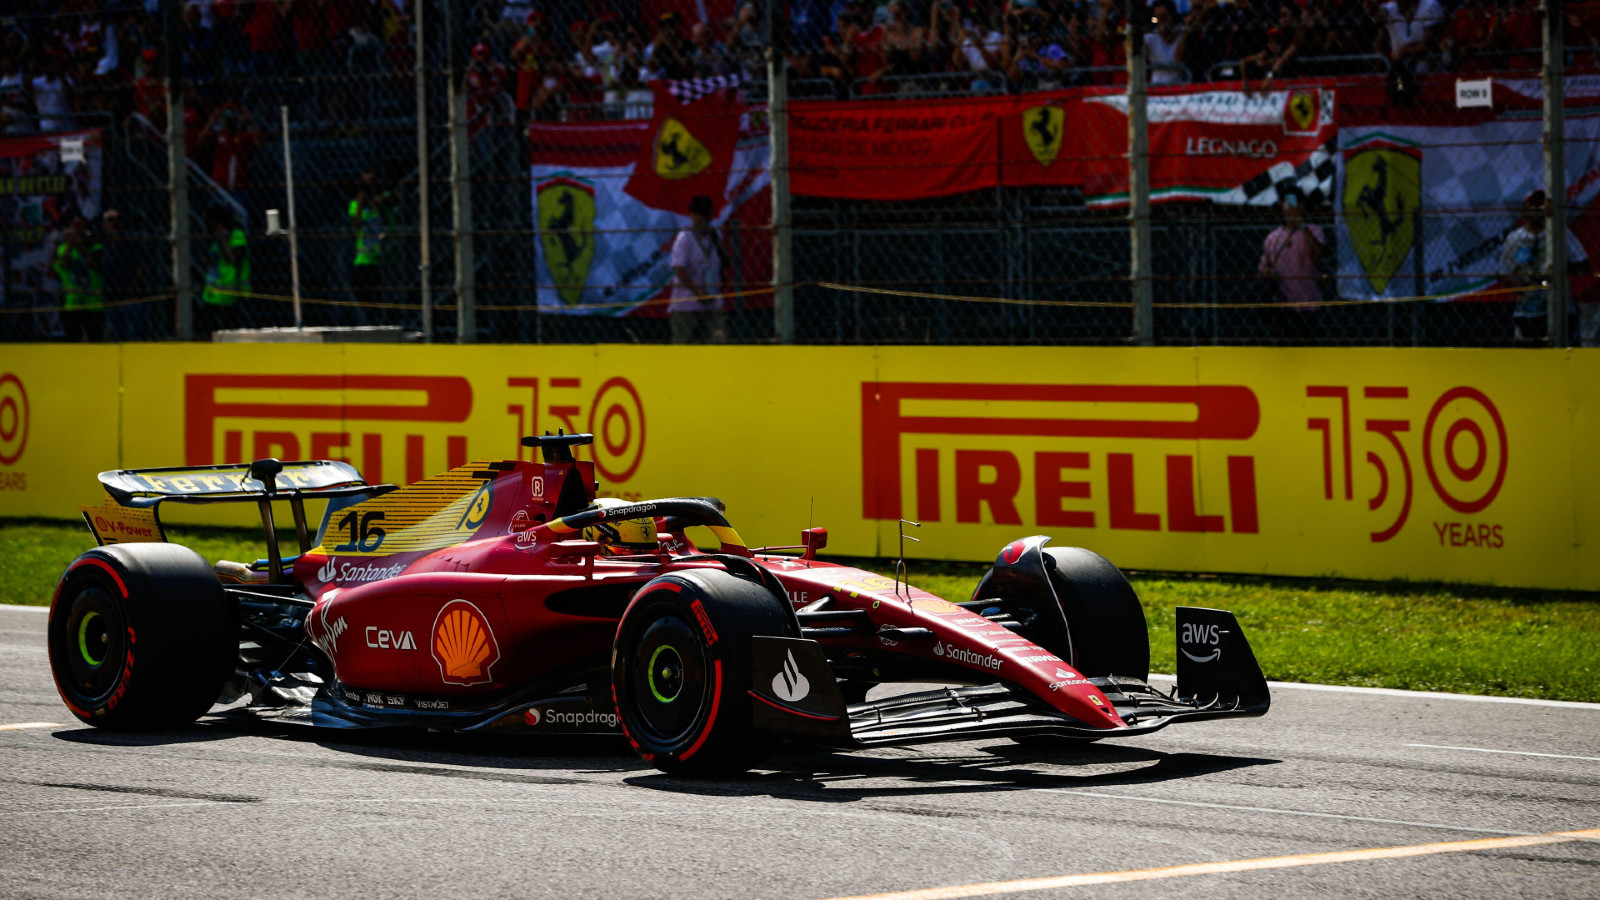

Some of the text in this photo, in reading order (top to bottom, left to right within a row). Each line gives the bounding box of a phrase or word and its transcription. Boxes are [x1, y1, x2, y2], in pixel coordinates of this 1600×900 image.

[1460, 89, 1480, 99] ROW
[1185, 136, 1279, 159] LEGNAGO
[861, 381, 1508, 543] PIRELLI 150
[608, 503, 657, 517] Snapdragon
[107, 519, 153, 538] V-Power
[334, 510, 387, 553] 16
[517, 530, 537, 543] aws
[1433, 521, 1505, 549] YEARS
[335, 562, 408, 582] Santander
[1182, 622, 1219, 646] aws
[946, 643, 1004, 671] Santander
[1048, 678, 1093, 692] Santand
[387, 696, 406, 706] SKF
[545, 709, 620, 728] Snapdrag
